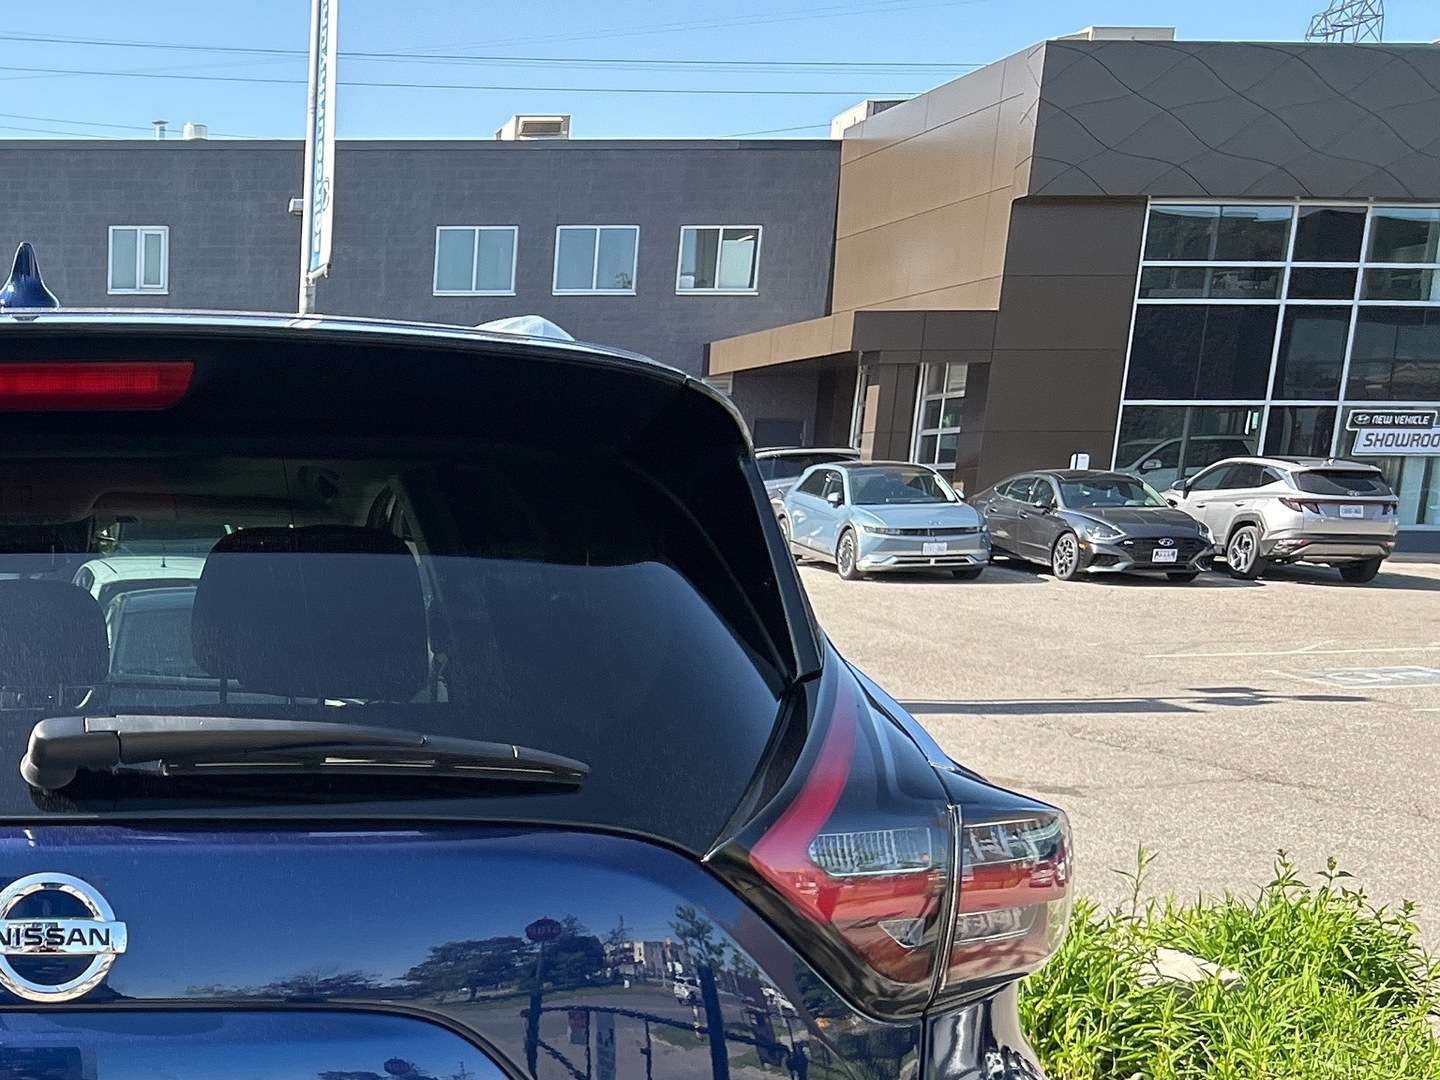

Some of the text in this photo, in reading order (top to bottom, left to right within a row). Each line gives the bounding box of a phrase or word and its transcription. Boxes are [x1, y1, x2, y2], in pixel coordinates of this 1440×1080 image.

[1372, 415, 1430, 425] NEW VEHICLE
[1363, 432, 1440, 447] SHOWROO
